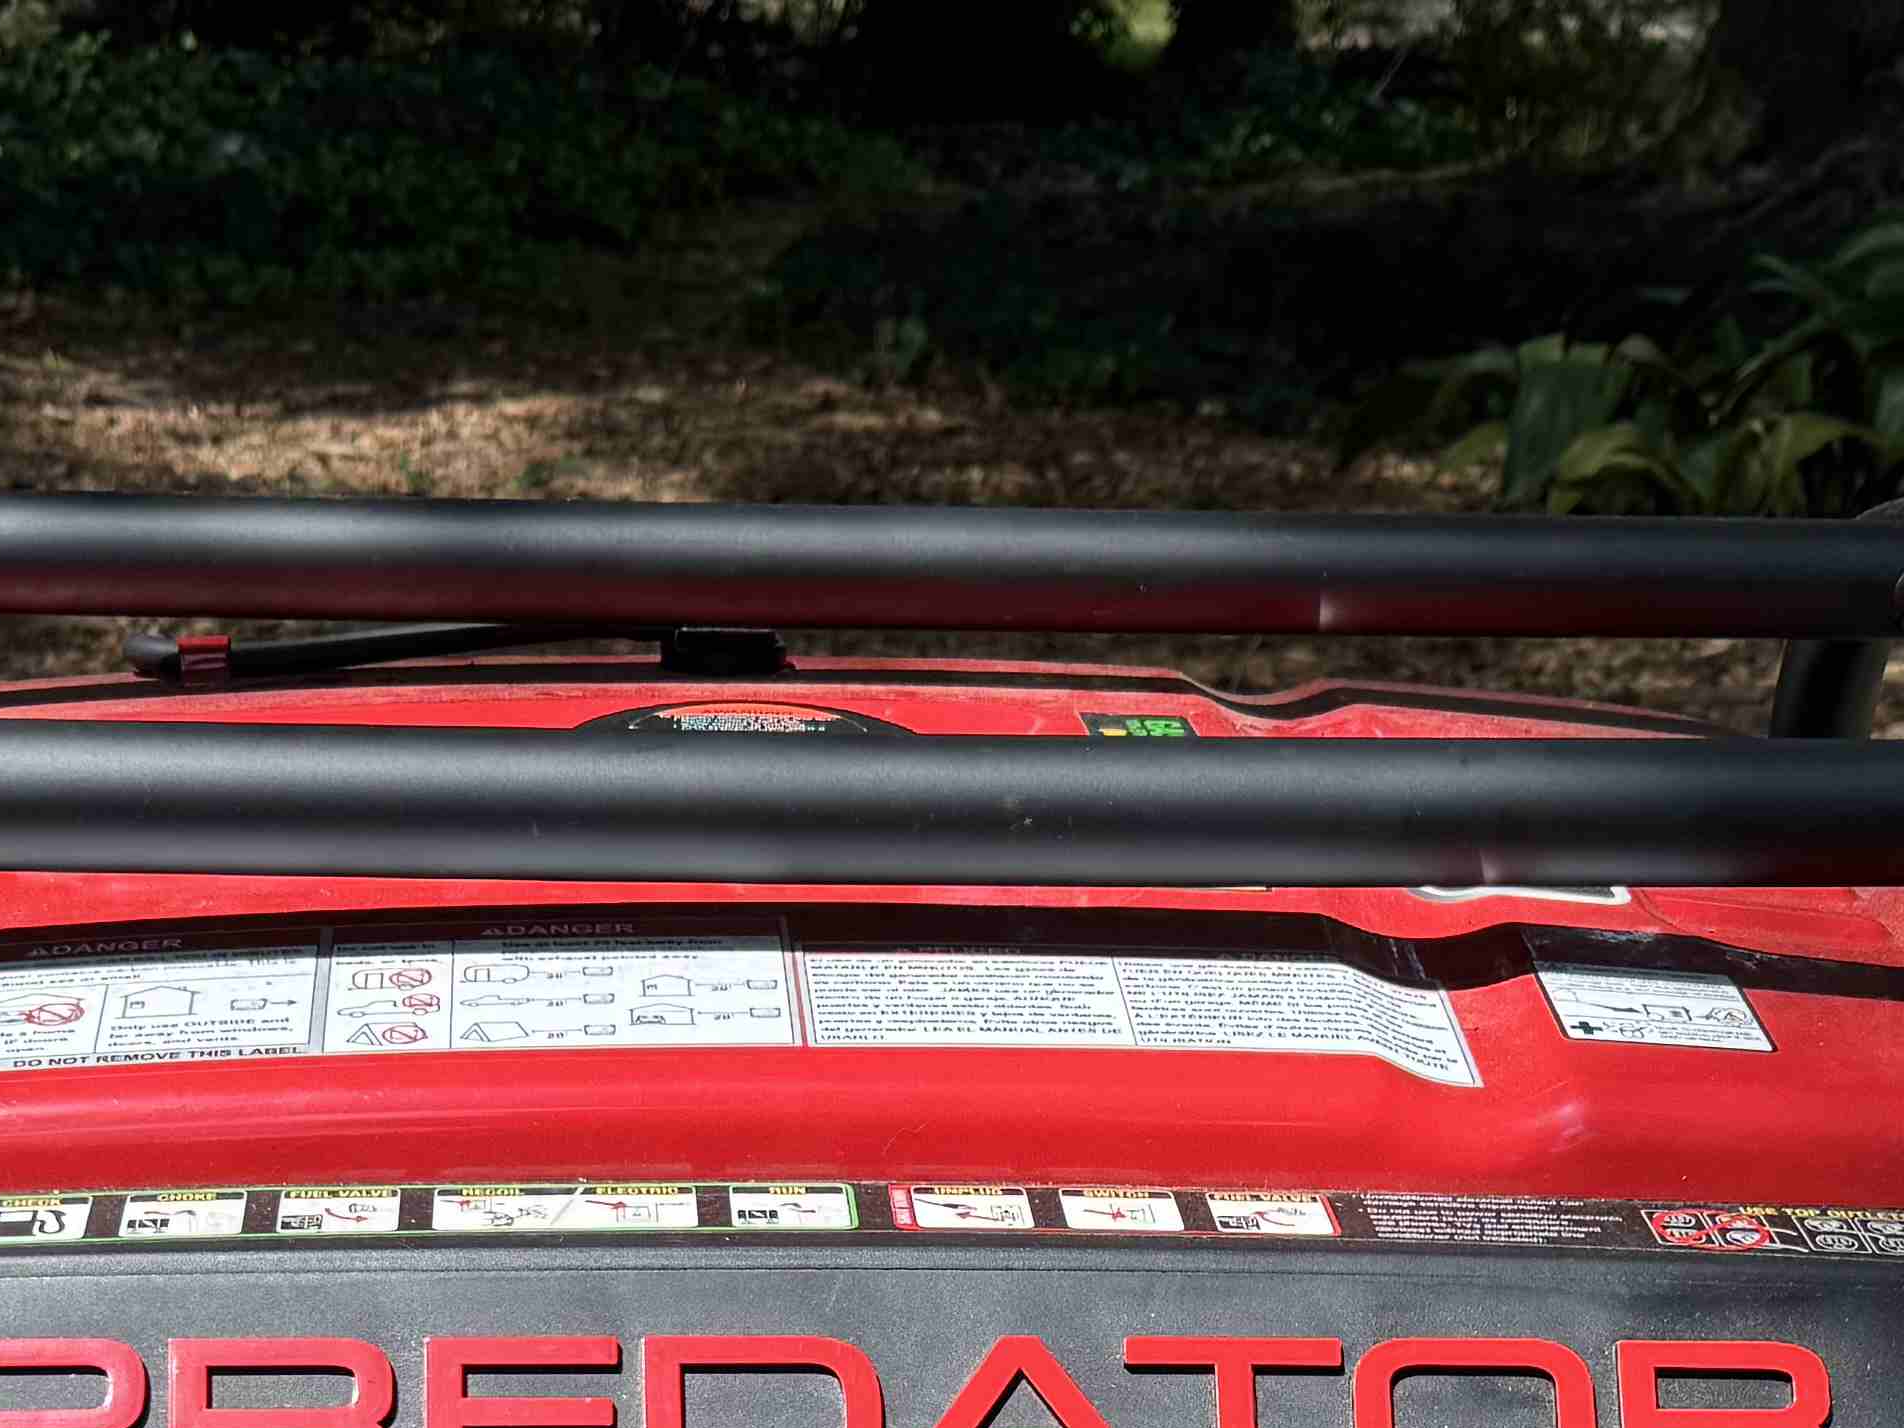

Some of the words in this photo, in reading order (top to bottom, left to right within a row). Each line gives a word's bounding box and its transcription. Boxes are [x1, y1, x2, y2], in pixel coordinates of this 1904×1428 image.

[505, 922, 634, 936] DANGER
[49, 938, 183, 955] DANGER
[13, 1057, 46, 1069] DO
[50, 1055, 88, 1067] NOT
[96, 1051, 180, 1065] REMOVE
[186, 1047, 232, 1060] THIS
[238, 1045, 304, 1058] LABEL
[289, 1188, 333, 1198] FUEL
[340, 1187, 395, 1198] VALVE
[461, 1186, 524, 1197] RECOIL
[594, 1185, 679, 1195] ELECTRIC
[1084, 1189, 1149, 1200] SWITCH
[158, 1191, 217, 1202] CHOKE
[1739, 1205, 1778, 1217] USE
[1782, 1207, 1820, 1218] TOP
